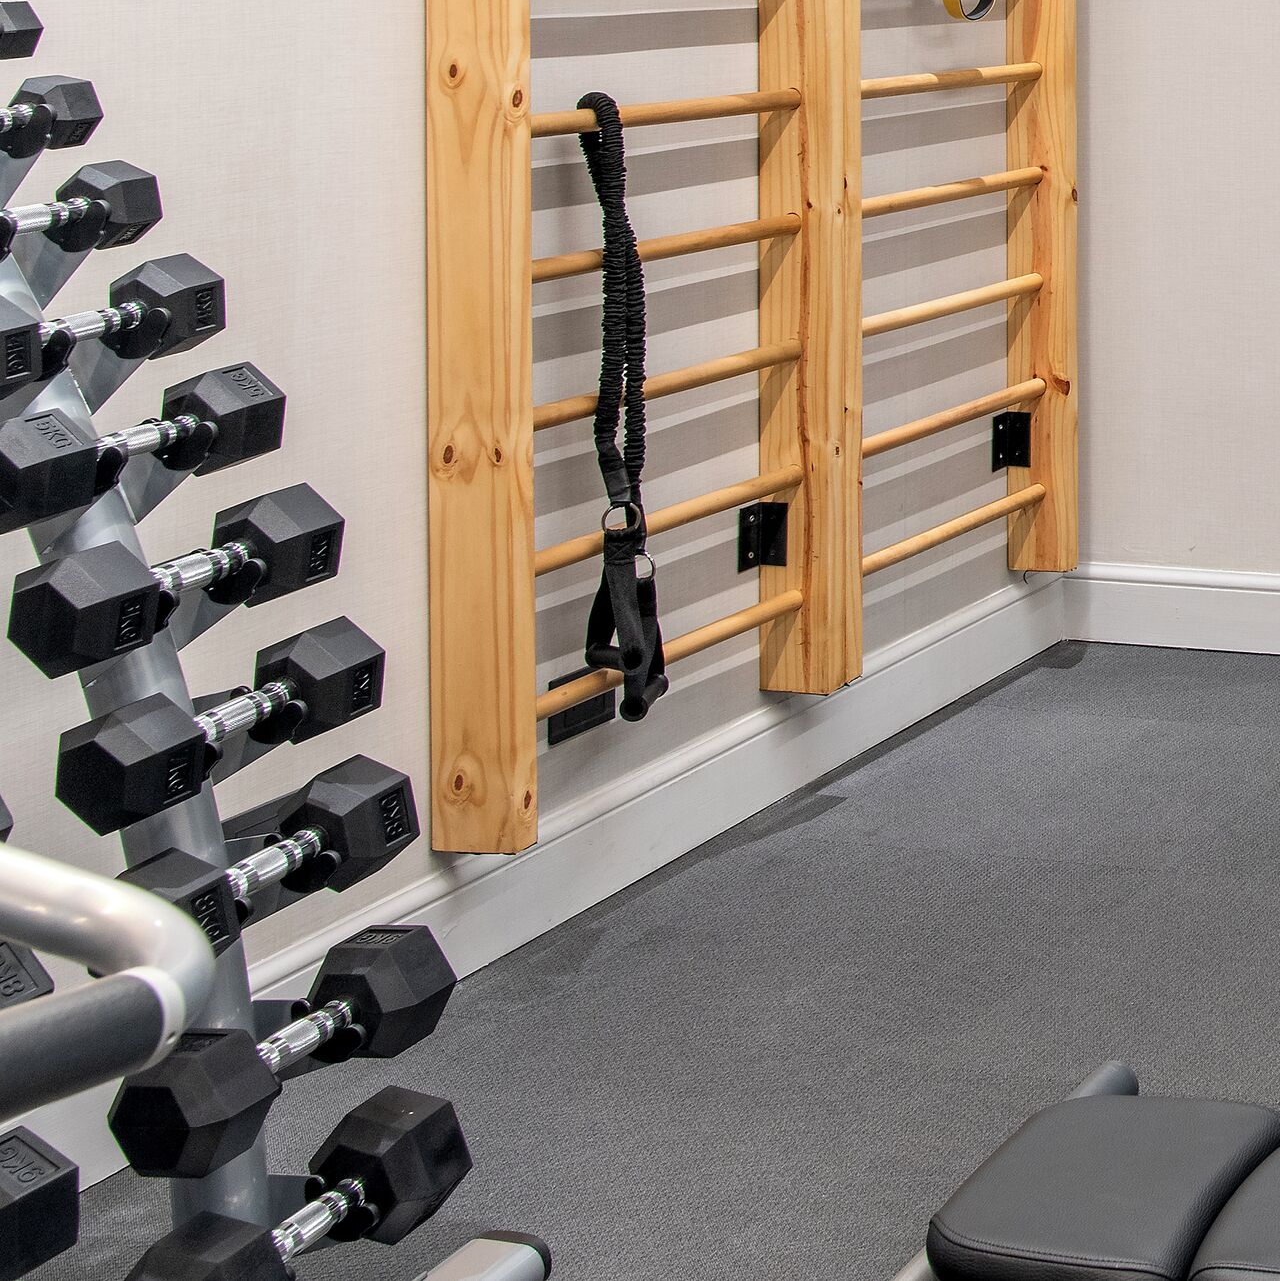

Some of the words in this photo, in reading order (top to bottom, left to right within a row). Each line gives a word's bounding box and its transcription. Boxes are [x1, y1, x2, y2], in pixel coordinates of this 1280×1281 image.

[231, 372, 265, 398] 5KG
[35, 421, 72, 449] 5KG
[381, 794, 403, 837] 8KG
[0, 957, 25, 997] 8K
